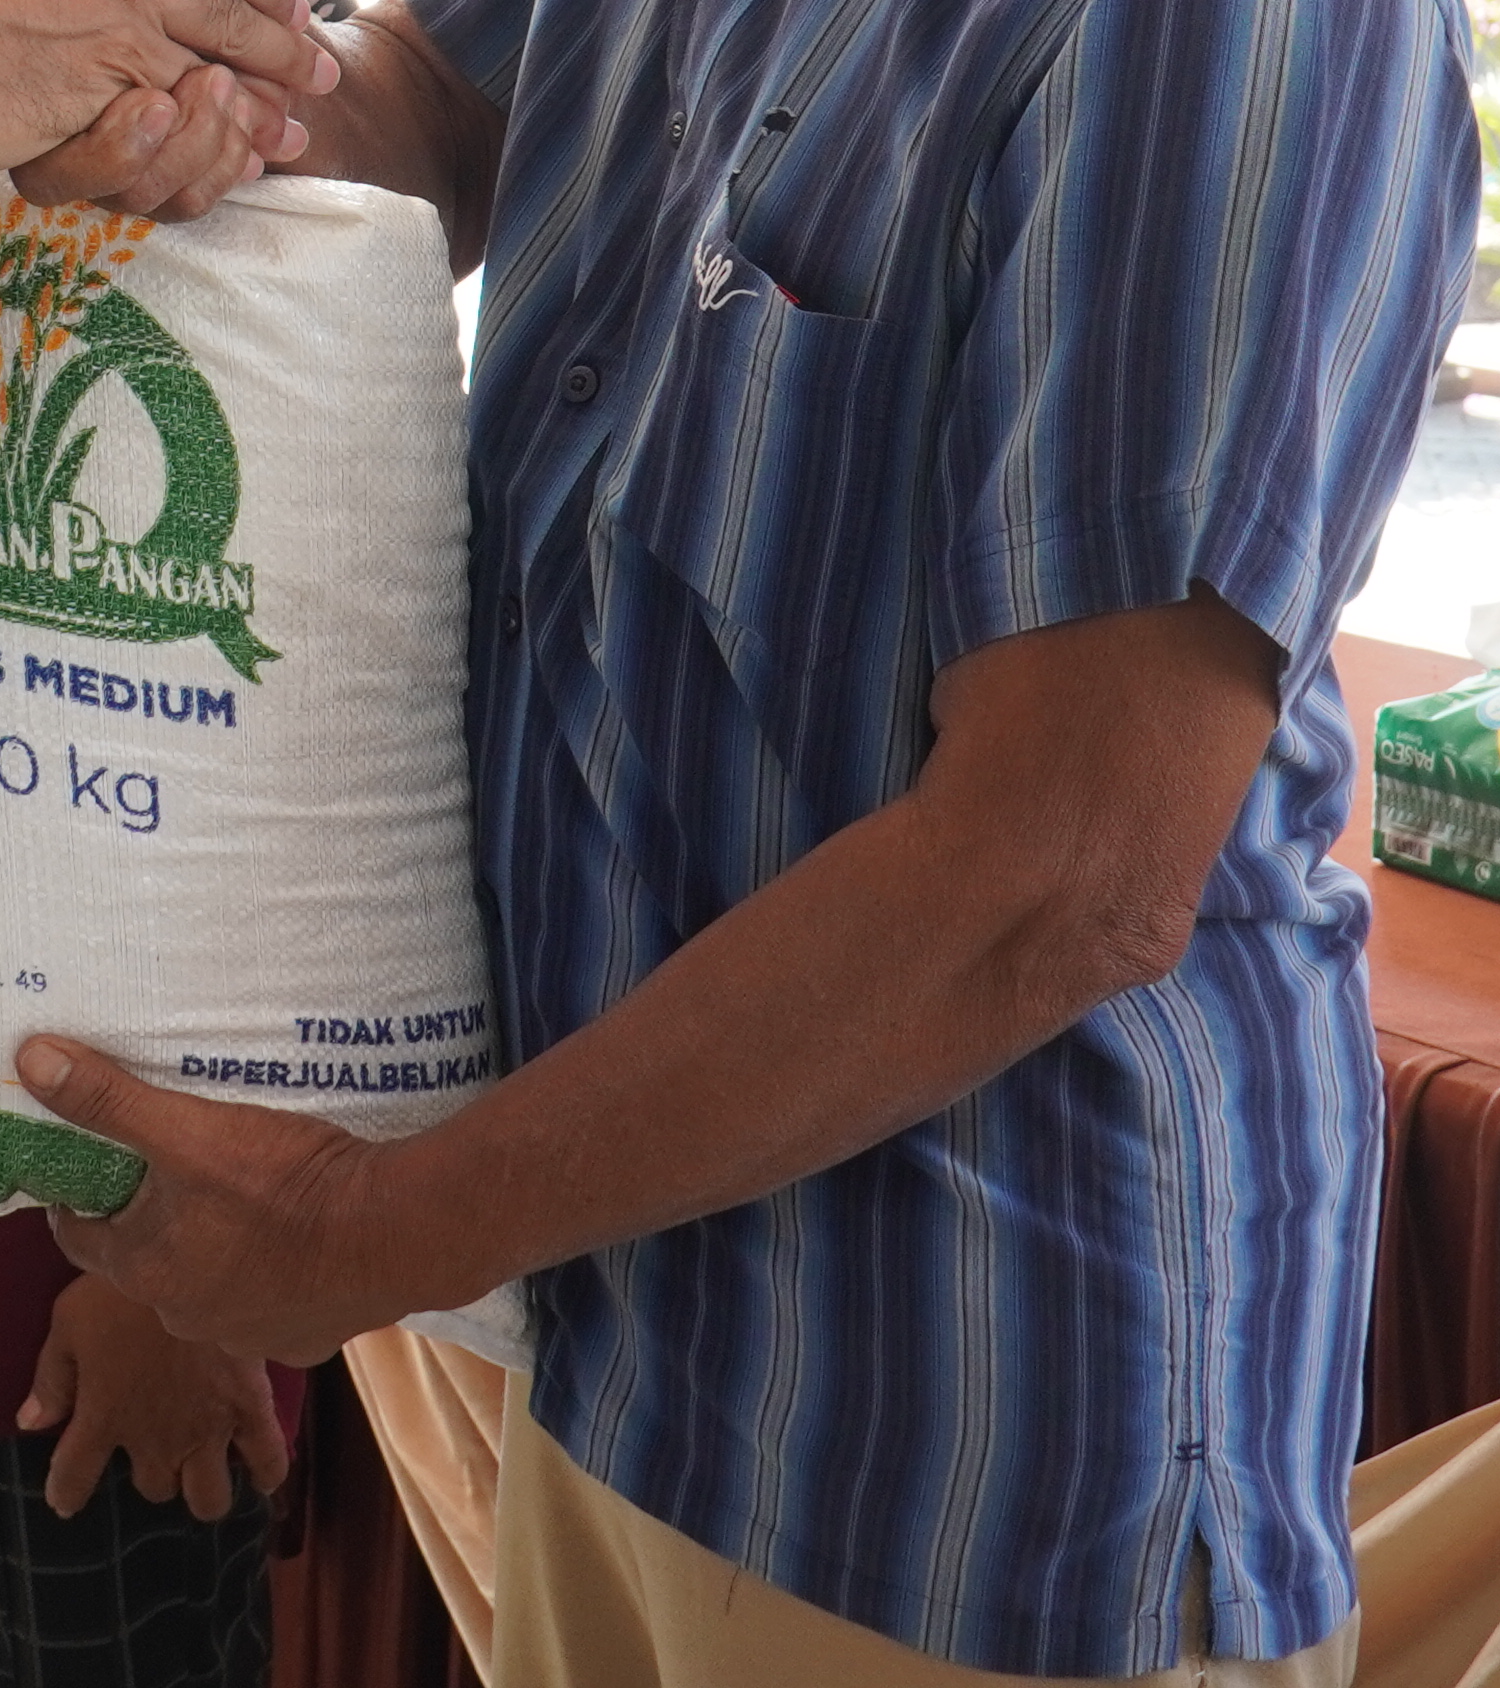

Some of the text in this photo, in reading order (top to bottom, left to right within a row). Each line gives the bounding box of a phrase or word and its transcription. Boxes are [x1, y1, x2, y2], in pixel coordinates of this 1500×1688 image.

[50, 500, 255, 615] PANGAN
[23, 653, 237, 728] MEDIUM
[1380, 739, 1435, 772] PASEO
[68, 743, 161, 834] kg
[15, 968, 47, 993] 49
[294, 1001, 486, 1046] TIDAK UNTUK
[180, 1051, 491, 1094] DIPERJUALBELIKAN
